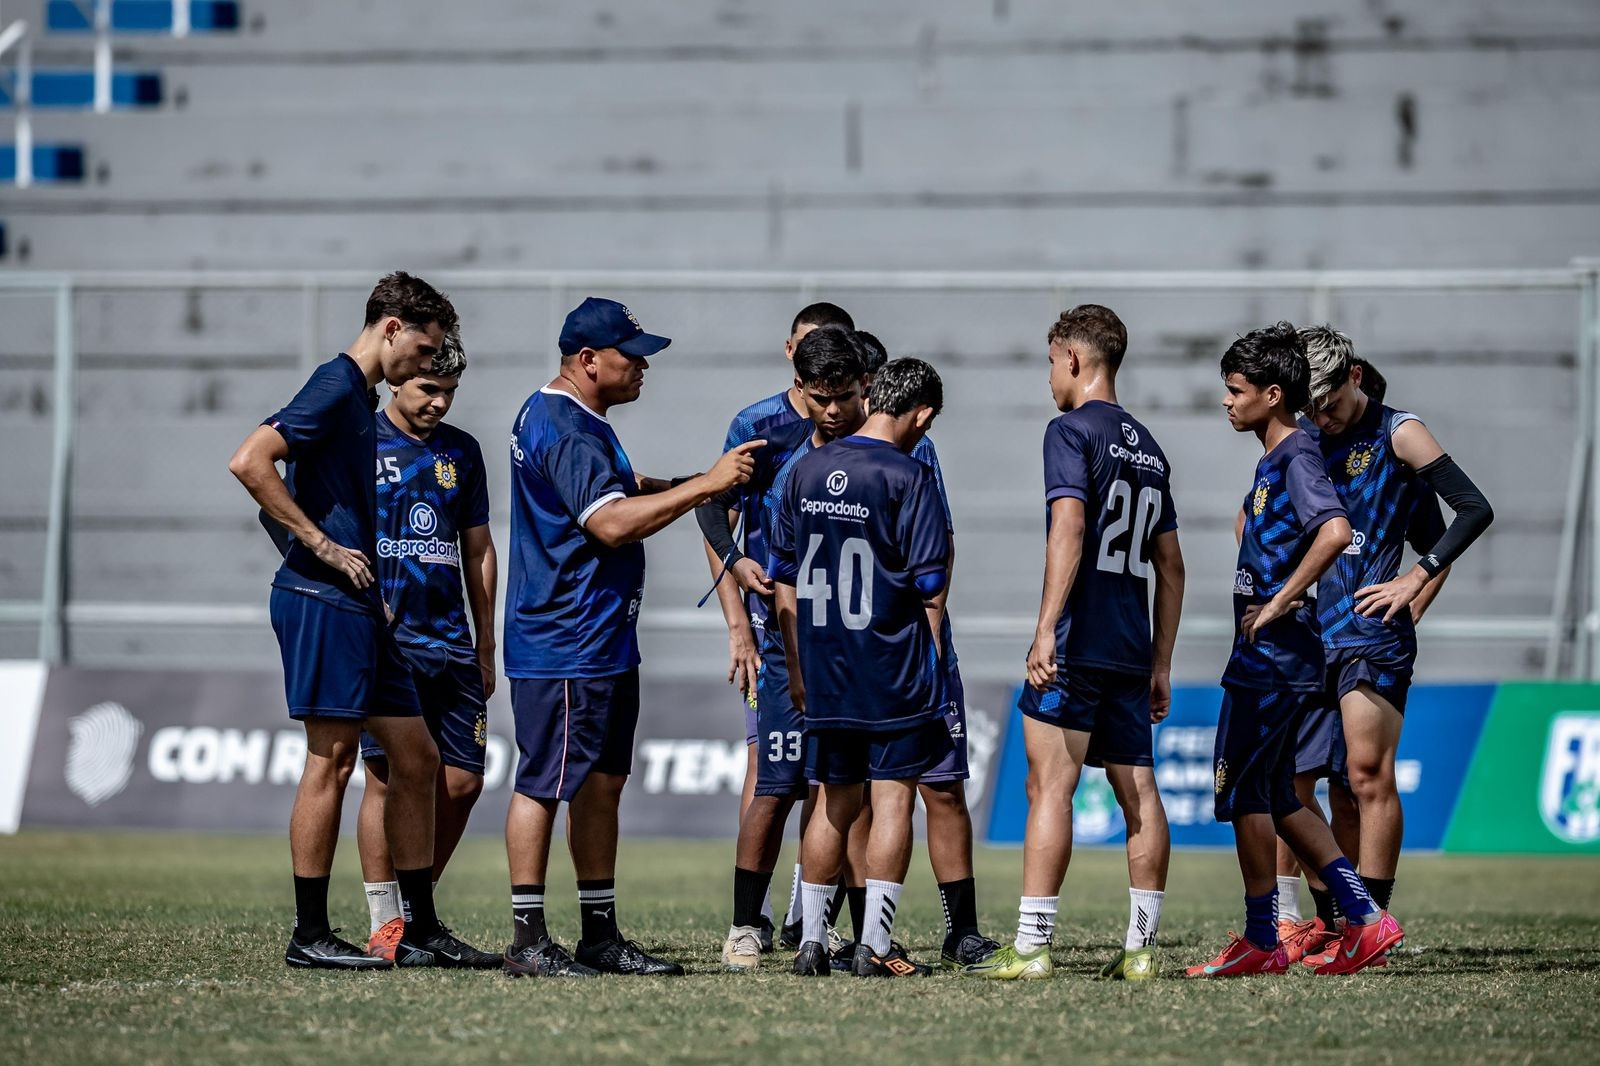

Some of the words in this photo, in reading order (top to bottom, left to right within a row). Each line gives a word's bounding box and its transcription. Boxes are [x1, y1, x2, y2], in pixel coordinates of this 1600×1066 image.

[1109, 443, 1164, 472] Cepodonto
[801, 498, 870, 519] Ceprodonto
[1097, 479, 1162, 579] 20
[796, 533, 875, 630] 40
[147, 725, 270, 785] COM
[639, 738, 749, 795] TEM
[768, 730, 802, 762] 33
